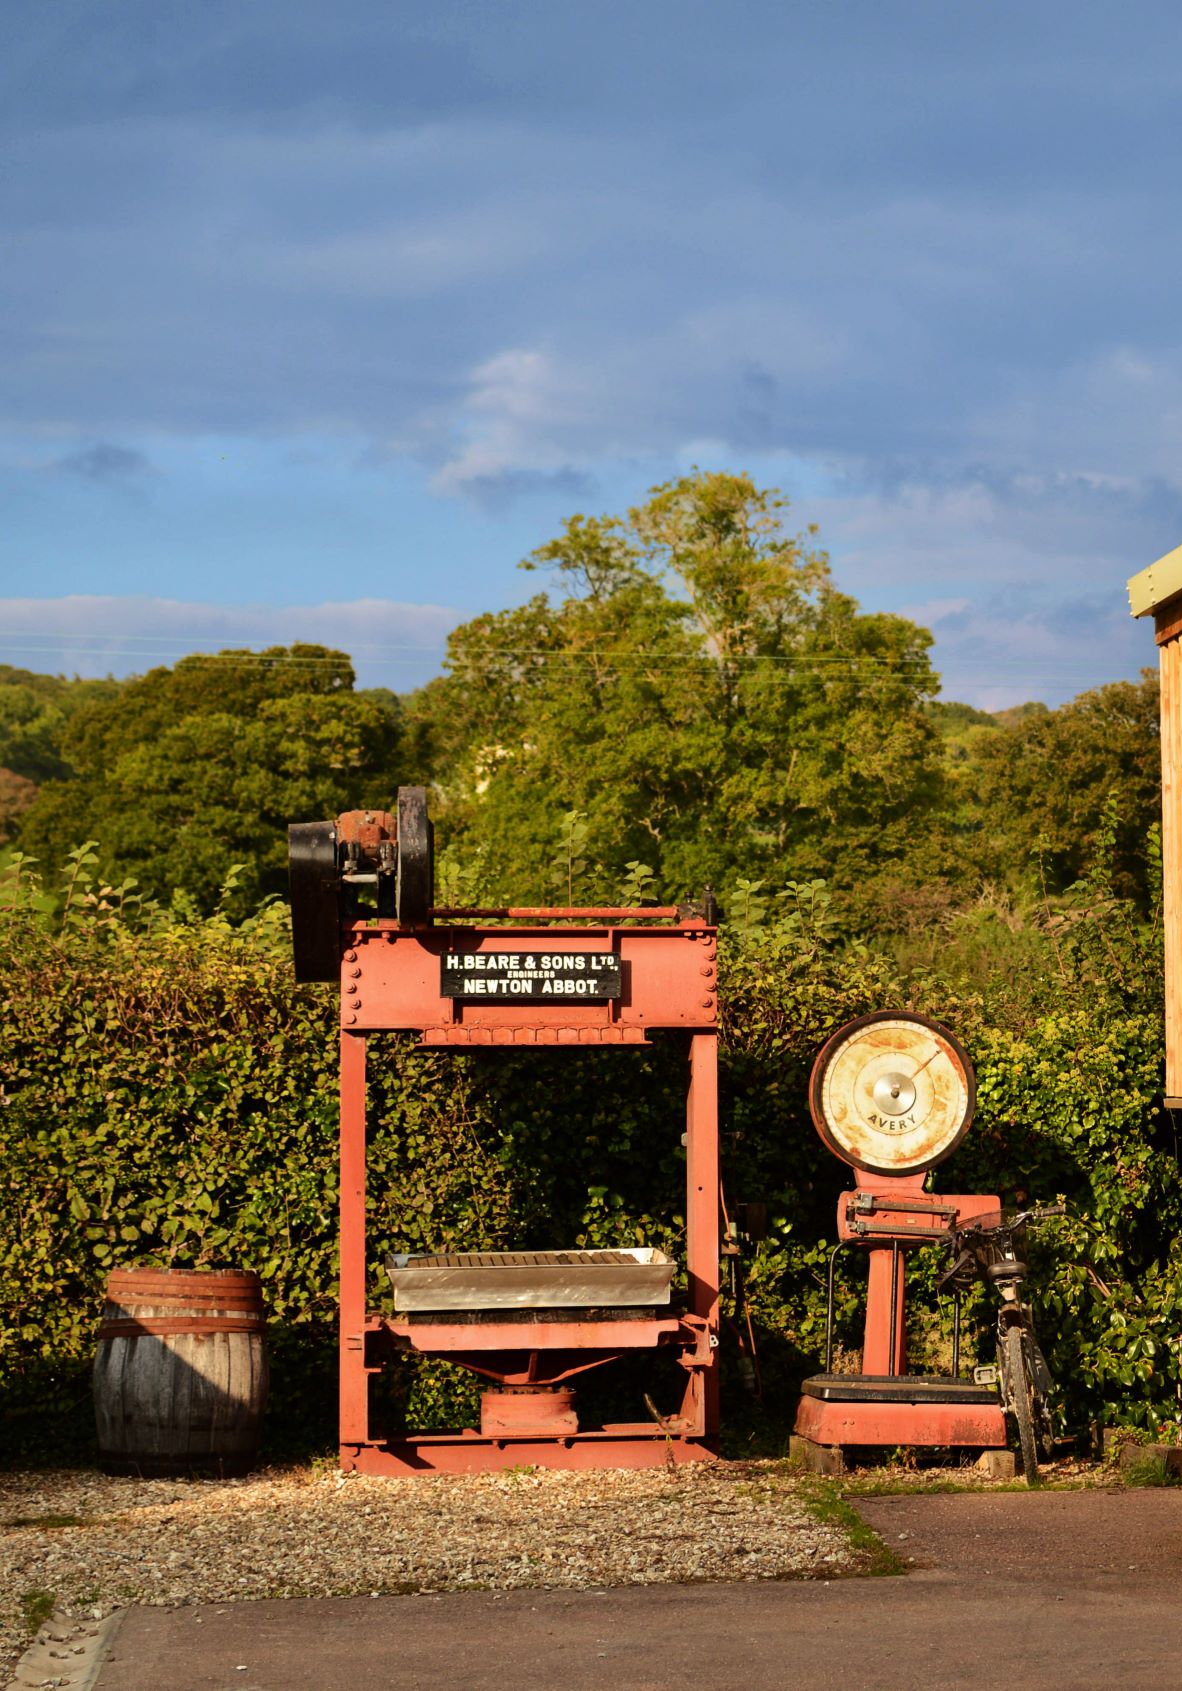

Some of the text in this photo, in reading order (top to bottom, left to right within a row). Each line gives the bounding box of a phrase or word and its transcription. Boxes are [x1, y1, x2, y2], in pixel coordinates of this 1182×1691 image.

[524, 955, 537, 970] &
[541, 955, 586, 970] SONS
[507, 970, 556, 979] ENGINEERS
[463, 979, 599, 994] NEWTON ABBOT.
[868, 1114, 916, 1130] AVERY
